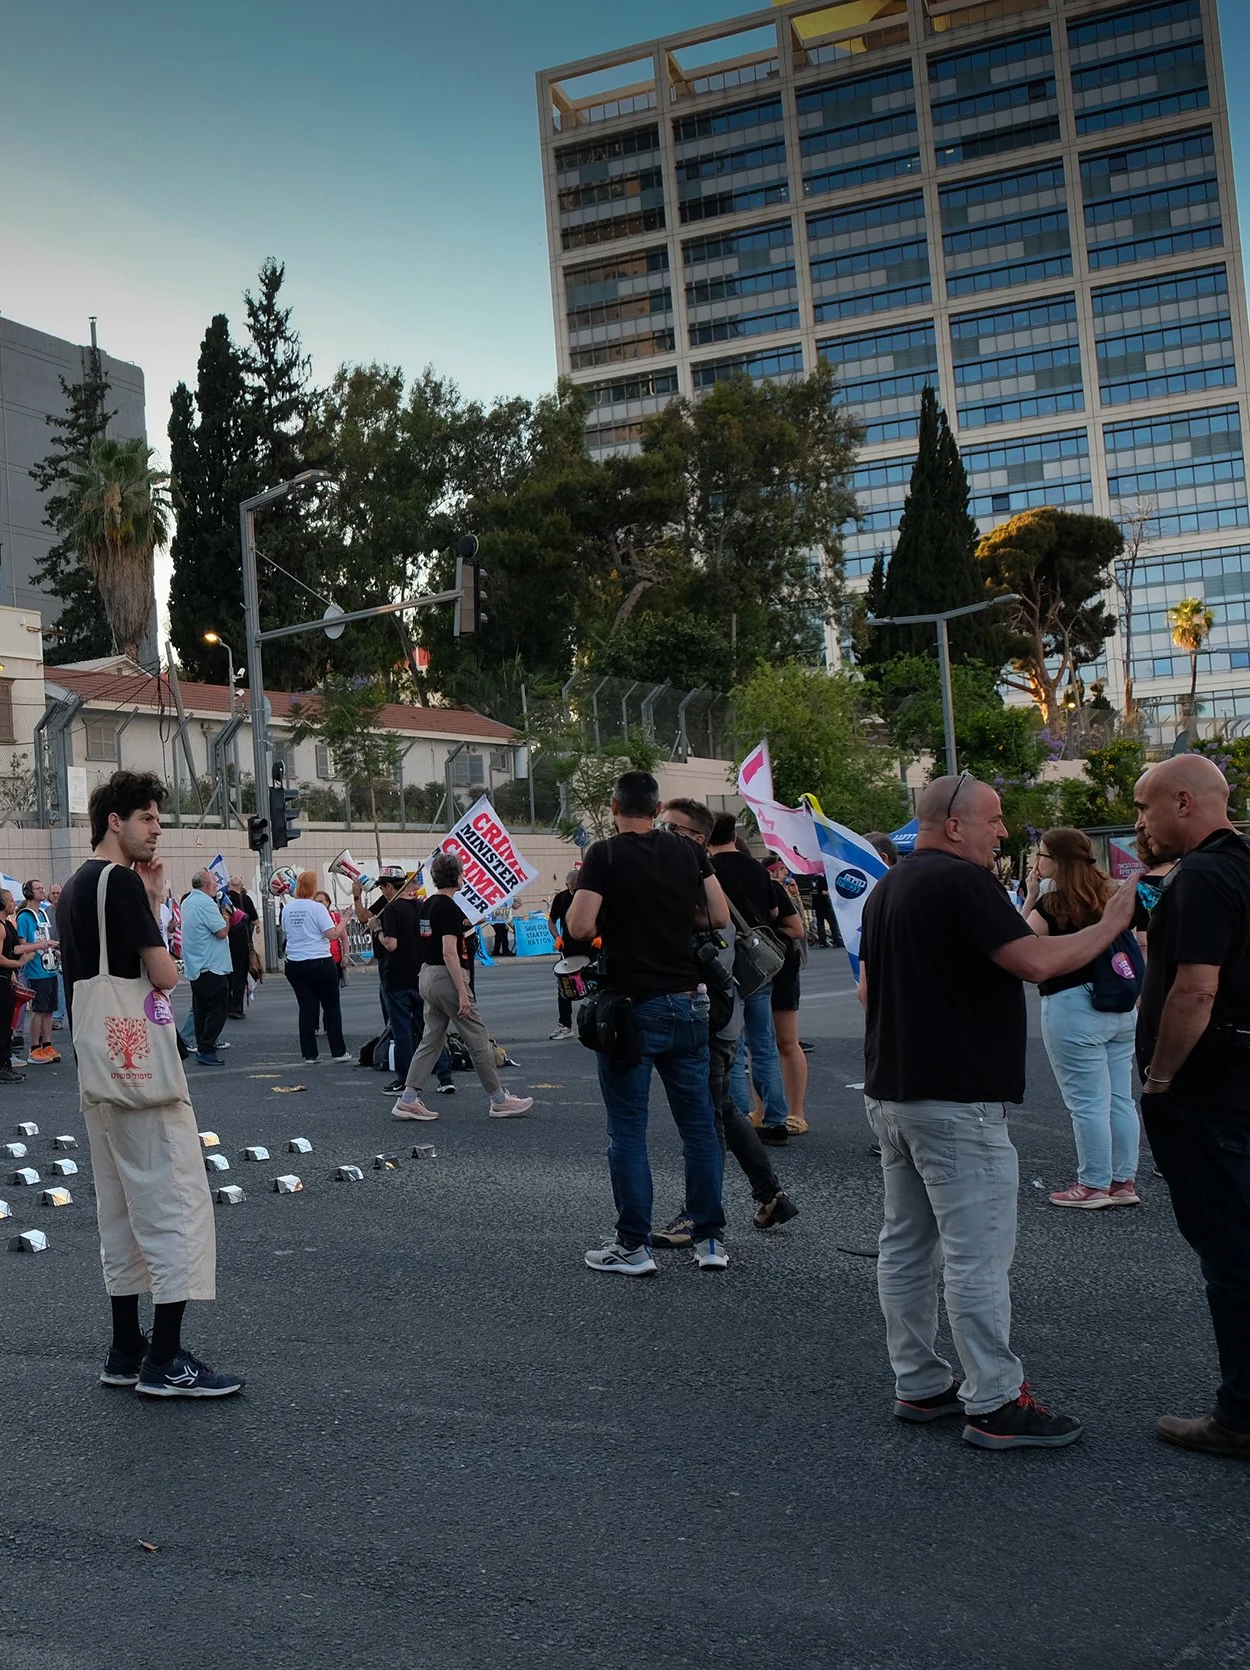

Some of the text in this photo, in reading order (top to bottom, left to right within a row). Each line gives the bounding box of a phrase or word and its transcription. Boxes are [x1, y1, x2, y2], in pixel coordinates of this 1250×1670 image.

[442, 837, 506, 906] CRIME
[460, 823, 519, 890] MINISTER
[526, 931, 550, 939] STARTUP
[110, 1072, 153, 1080] סיפור פשוט
